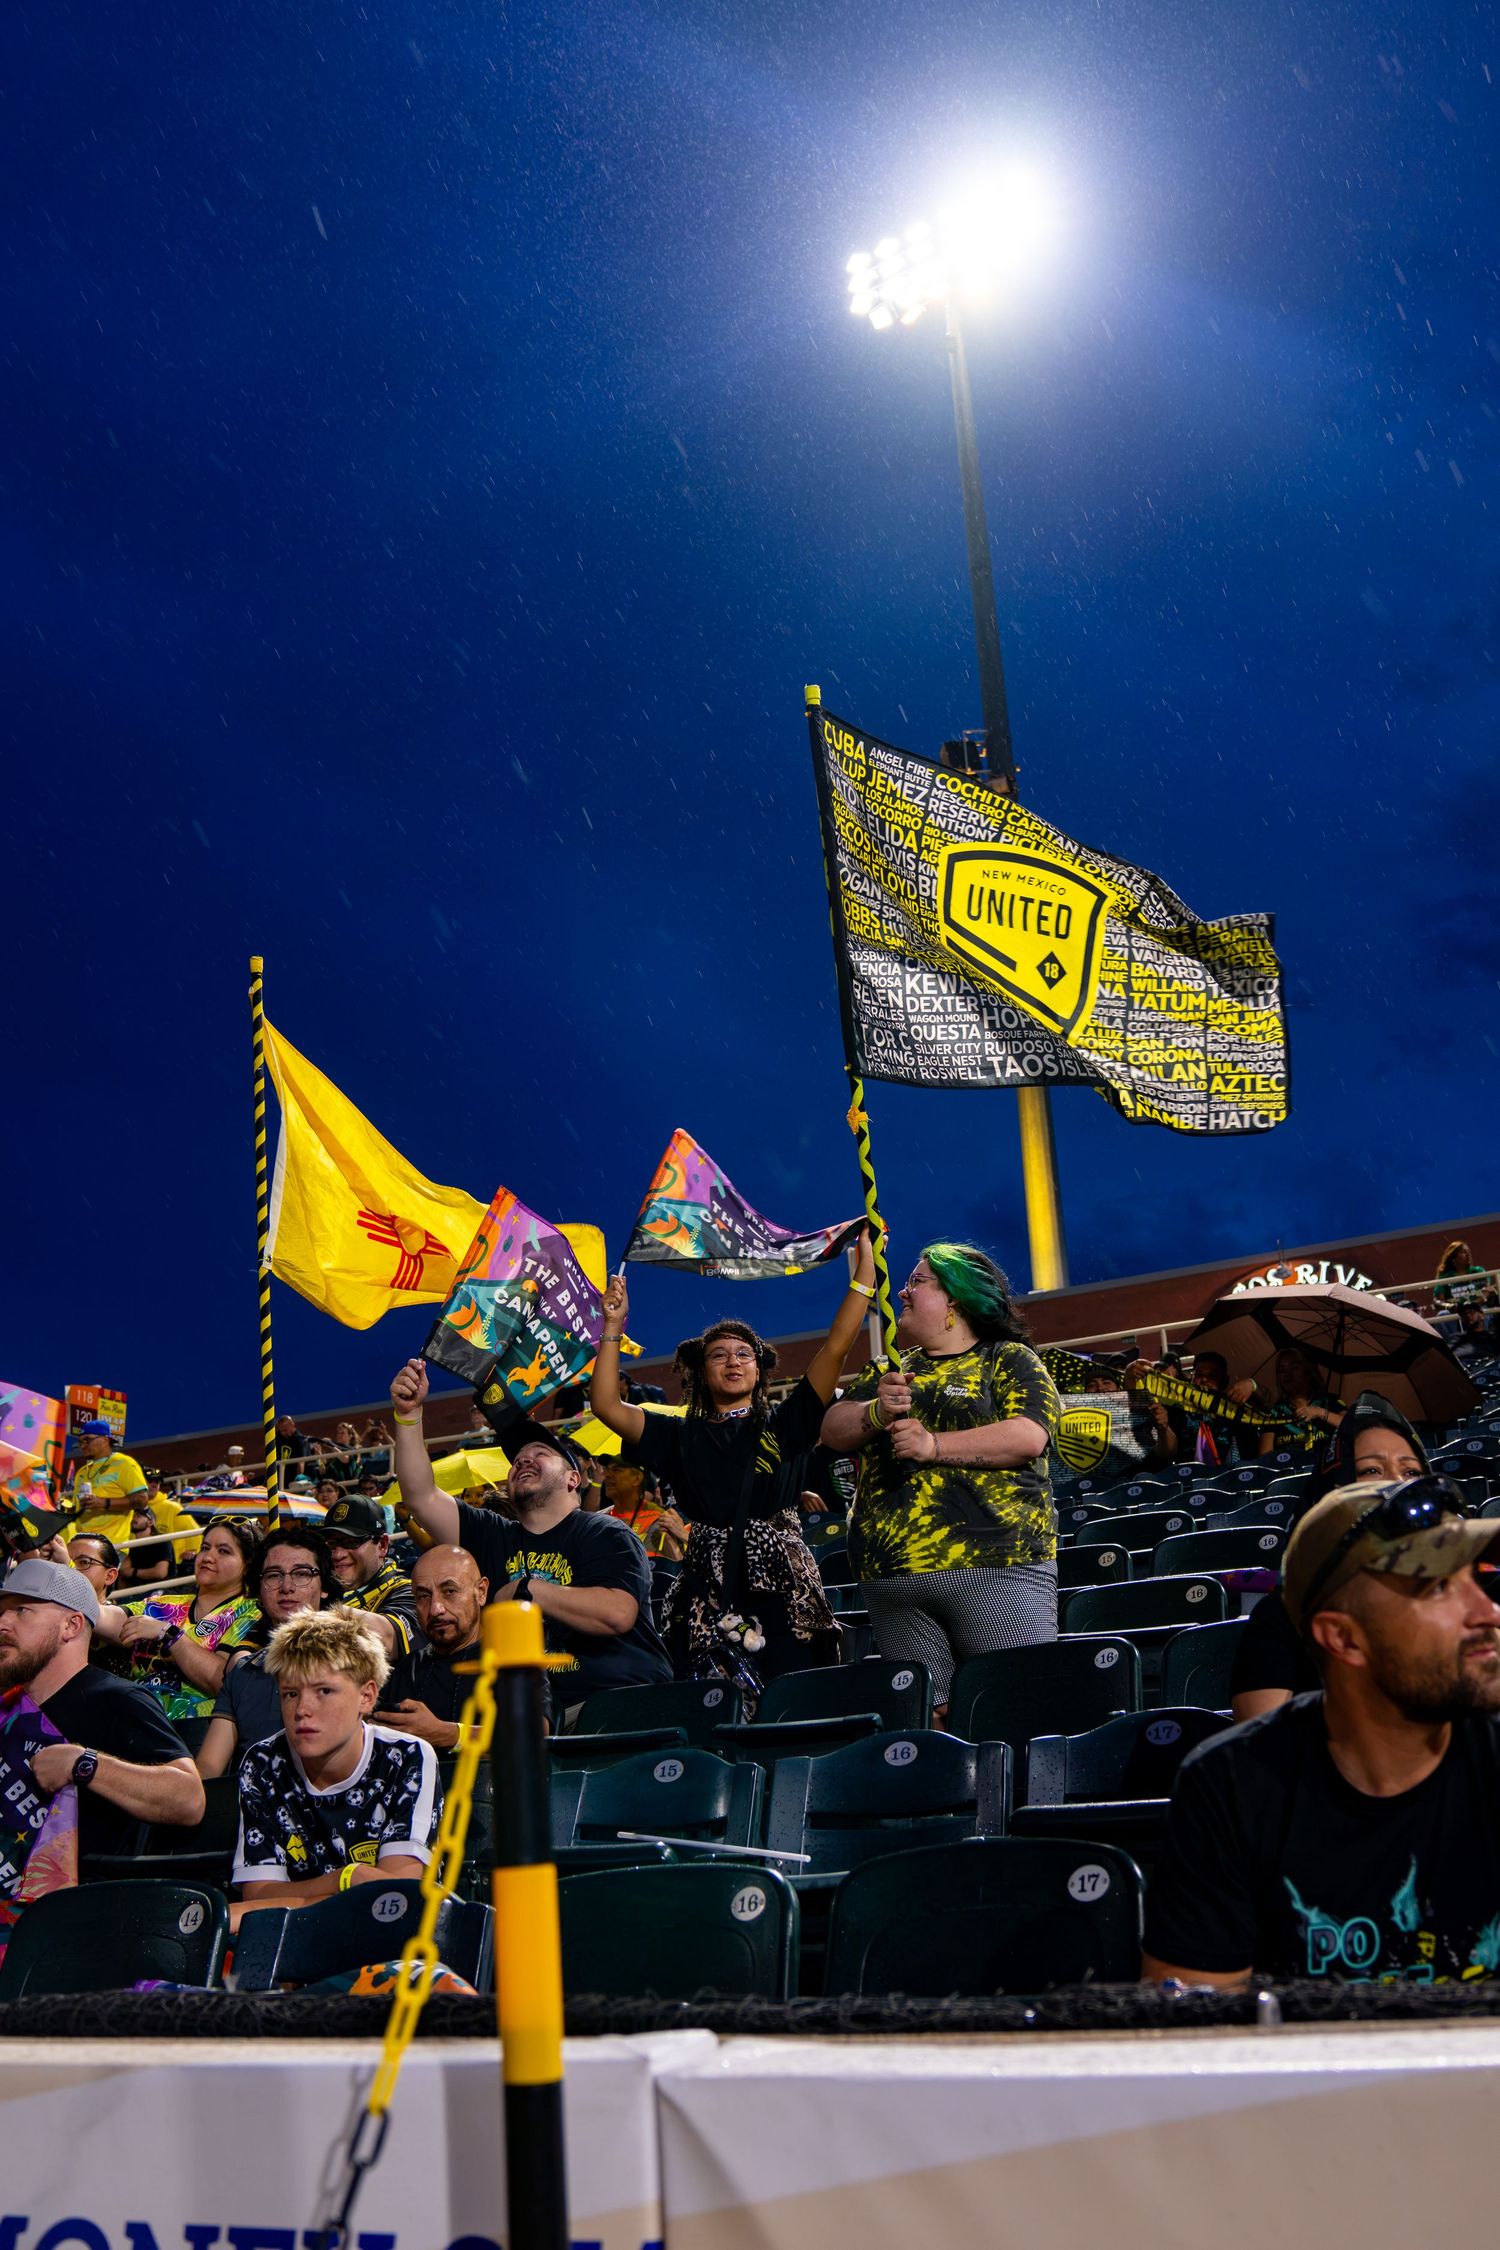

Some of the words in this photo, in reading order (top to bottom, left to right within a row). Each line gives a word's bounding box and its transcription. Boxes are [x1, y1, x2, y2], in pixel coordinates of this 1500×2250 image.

[824, 720, 867, 766] CUBA
[868, 758, 904, 778] ELEPHANT
[904, 771, 932, 788] BUTTE
[869, 747, 905, 769] ANGEL
[906, 761, 935, 780] FIRE
[867, 769, 929, 806] JEMEZ
[935, 773, 1010, 810] COCHITI
[865, 787, 882, 802] LOS
[882, 795, 925, 817] ALAMOS
[931, 787, 1006, 820] MESCALERO
[865, 799, 922, 830] SOCORRO
[928, 797, 1003, 832] RESERVE
[867, 814, 918, 853] ELIDA
[923, 826, 940, 838] RIO
[925, 813, 998, 842] ANTHONY
[1006, 812, 1079, 855] CAPITAN
[871, 836, 917, 871] CLOVIS
[871, 852, 888, 868] LAKE
[888, 863, 917, 881] ARTHUR
[840, 867, 881, 900] OGAN
[872, 864, 918, 900] FLOYD
[982, 869, 1011, 881] NEW
[1016, 874, 1067, 896] MEXICO
[1074, 857, 1146, 897] LOVING
[842, 895, 880, 929] OBBS
[967, 884, 1072, 940] UNITED
[1197, 913, 1270, 937] ARTESIA
[1131, 948, 1205, 967] VAUGHN
[1200, 939, 1273, 962] MAXWELL
[905, 957, 963, 974] CAUSEY
[1043, 962, 1059, 979] 18
[1131, 962, 1204, 979] BAYARD
[871, 977, 902, 988] ROSA
[905, 973, 975, 995] KEWA
[1131, 978, 1206, 992] WILLARD
[853, 979, 904, 1008] BELEN
[1130, 992, 1207, 1011] TATUM
[1207, 991, 1281, 1013] MESILLA
[905, 996, 979, 1012] DEXTER
[908, 1014, 944, 1023] WAGON
[945, 1013, 980, 1022] MOUND
[982, 1007, 1045, 1030] HOPE
[1087, 1015, 1124, 1029] GILA
[1128, 1011, 1206, 1021] HAGERMAN
[1206, 1013, 1238, 1024] SAN
[1206, 1016, 1282, 1035] ACOMA
[887, 1021, 907, 1031] PARK
[910, 1024, 981, 1043] QUESTA
[985, 1031, 1022, 1040] BOSQUE
[1023, 1030, 1050, 1040] FARMS
[1127, 1021, 1204, 1032] COLUMBUS
[873, 1028, 897, 1049] OR
[898, 1031, 911, 1050] C
[914, 1043, 952, 1055] SILVER
[954, 1042, 982, 1054] CITY
[985, 1040, 1054, 1055] RUIDOSO
[1126, 1040, 1164, 1051] SAN
[1167, 1036, 1205, 1049] JON
[1206, 1043, 1230, 1051] RIO
[1231, 1039, 1284, 1052] RANCHO
[864, 1043, 915, 1067] DEMING
[917, 1056, 950, 1066] EAGLE
[952, 1055, 982, 1066] NEST
[1127, 1048, 1205, 1065] CORONA
[1207, 1049, 1286, 1062] LOVINGTON
[867, 1059, 917, 1080] MORIARTY
[920, 1066, 986, 1080] ROSWELL
[987, 1053, 1059, 1078] TAOS
[1130, 1061, 1207, 1082] MILAN
[1207, 1060, 1286, 1074] TULAROSA
[1209, 1073, 1287, 1093] AZTEC
[1136, 1093, 1208, 1114] CIMARRON
[1209, 1103, 1229, 1112] SAN
[1211, 1093, 1241, 1103] JEMEZ
[1136, 1102, 1209, 1130] NAMBE
[1209, 1110, 1287, 1130] HATCH
[712, 1200, 744, 1237] THE
[1294, 1260, 1387, 1301] RIVE
[493, 1288, 535, 1320] CAN
[524, 1257, 560, 1290] THE
[556, 1288, 602, 1343] BEST
[539, 1296, 557, 1320] THAT
[526, 1315, 573, 1381] APPEN
[77, 1389, 93, 1404] 118
[75, 1409, 93, 1423] 120
[1065, 1422, 1101, 1434] UNITED
[833, 1464, 854, 1476] UNITED
[1170, 1520, 1179, 1529] 15
[1263, 1538, 1274, 1546] 16
[1102, 1555, 1112, 1564] 15
[1192, 1588, 1203, 1598] 16
[1100, 1652, 1114, 1664] 16
[896, 1674, 909, 1686] 15
[708, 1692, 720, 1703] 14
[1153, 1725, 1173, 1740] 17
[891, 1746, 910, 1760] 16
[659, 1764, 677, 1778] 15
[4, 1779, 50, 1829] BES
[1077, 1873, 1100, 1893] 17
[378, 1899, 400, 1915] 15
[738, 1894, 759, 1913] 16
[183, 1910, 199, 1927] 14
